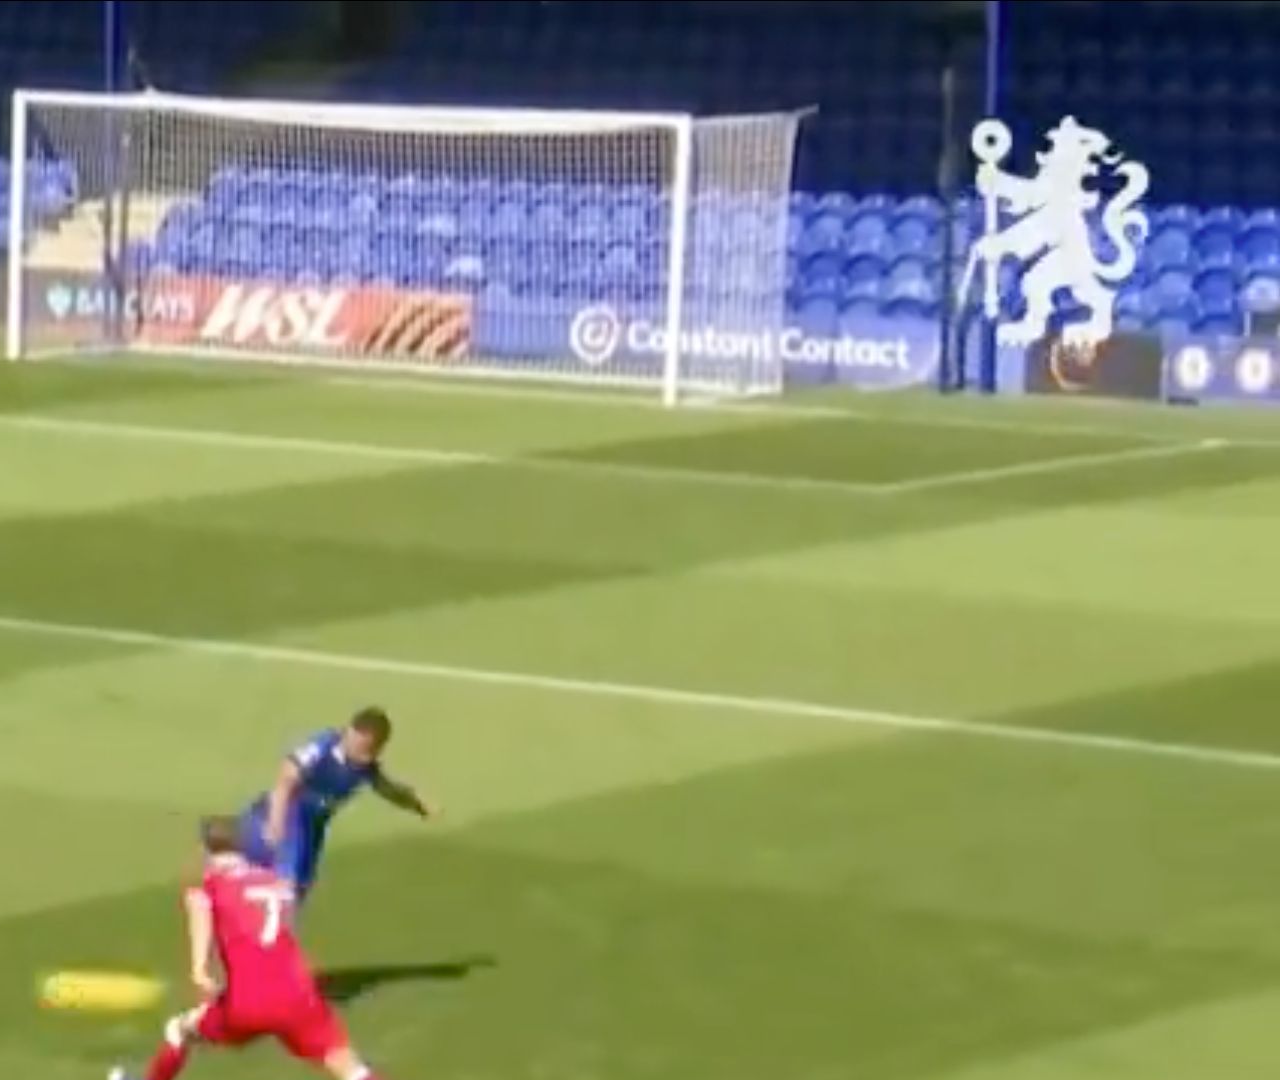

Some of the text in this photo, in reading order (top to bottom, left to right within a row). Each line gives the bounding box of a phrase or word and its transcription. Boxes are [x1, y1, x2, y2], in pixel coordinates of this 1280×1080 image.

[201, 283, 349, 343] WSL
[779, 325, 909, 370] Contact
[243, 885, 282, 947] 7
